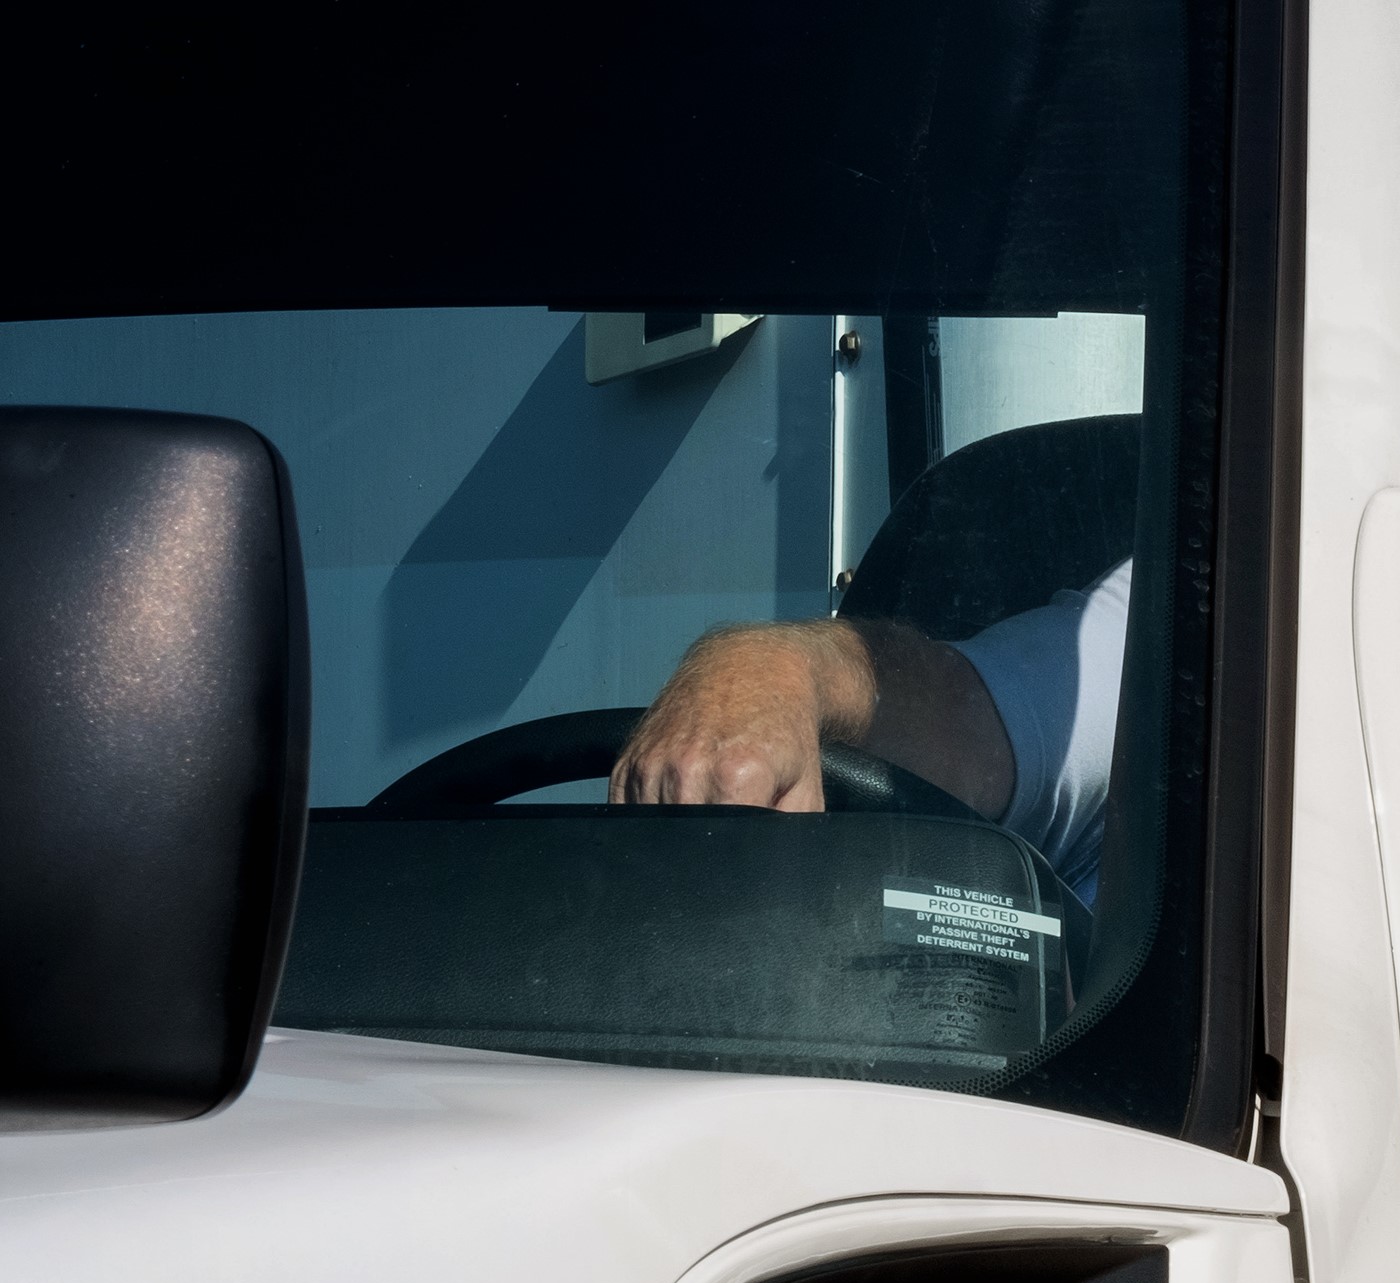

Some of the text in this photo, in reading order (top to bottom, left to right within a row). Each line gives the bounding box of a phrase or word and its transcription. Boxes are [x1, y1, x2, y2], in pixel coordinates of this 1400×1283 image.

[934, 885, 1014, 907] THIS VEHICLE
[929, 899, 1019, 923] PROTECTED
[917, 912, 1030, 939] BY INTERNATIONAL'S
[932, 925, 1015, 947] PASSIVE THEFT
[917, 934, 1030, 962] DETERRENT SYSTEM
